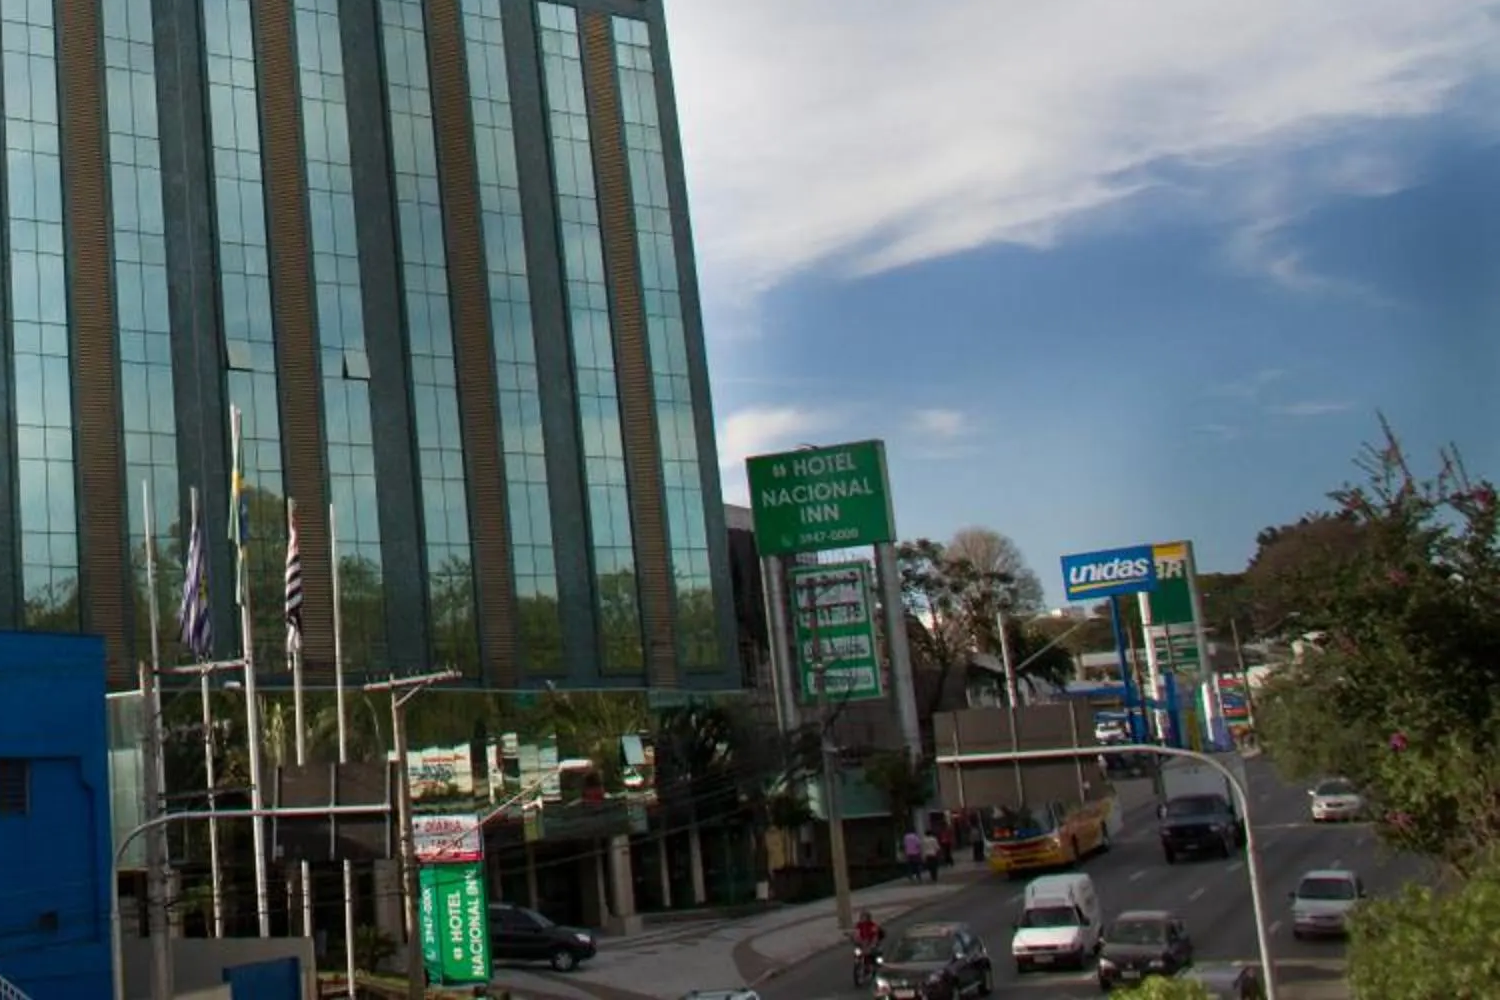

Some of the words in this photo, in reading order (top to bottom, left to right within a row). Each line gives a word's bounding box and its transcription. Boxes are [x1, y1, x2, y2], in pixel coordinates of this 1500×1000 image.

[793, 452, 857, 477] HOTEL
[762, 477, 874, 507] NACIONAL
[800, 504, 840, 524] INN
[1069, 557, 1150, 584] unidas
[465, 869, 480, 896] INN
[447, 889, 464, 943] HOTEL
[467, 898, 485, 977] NACIONAL
